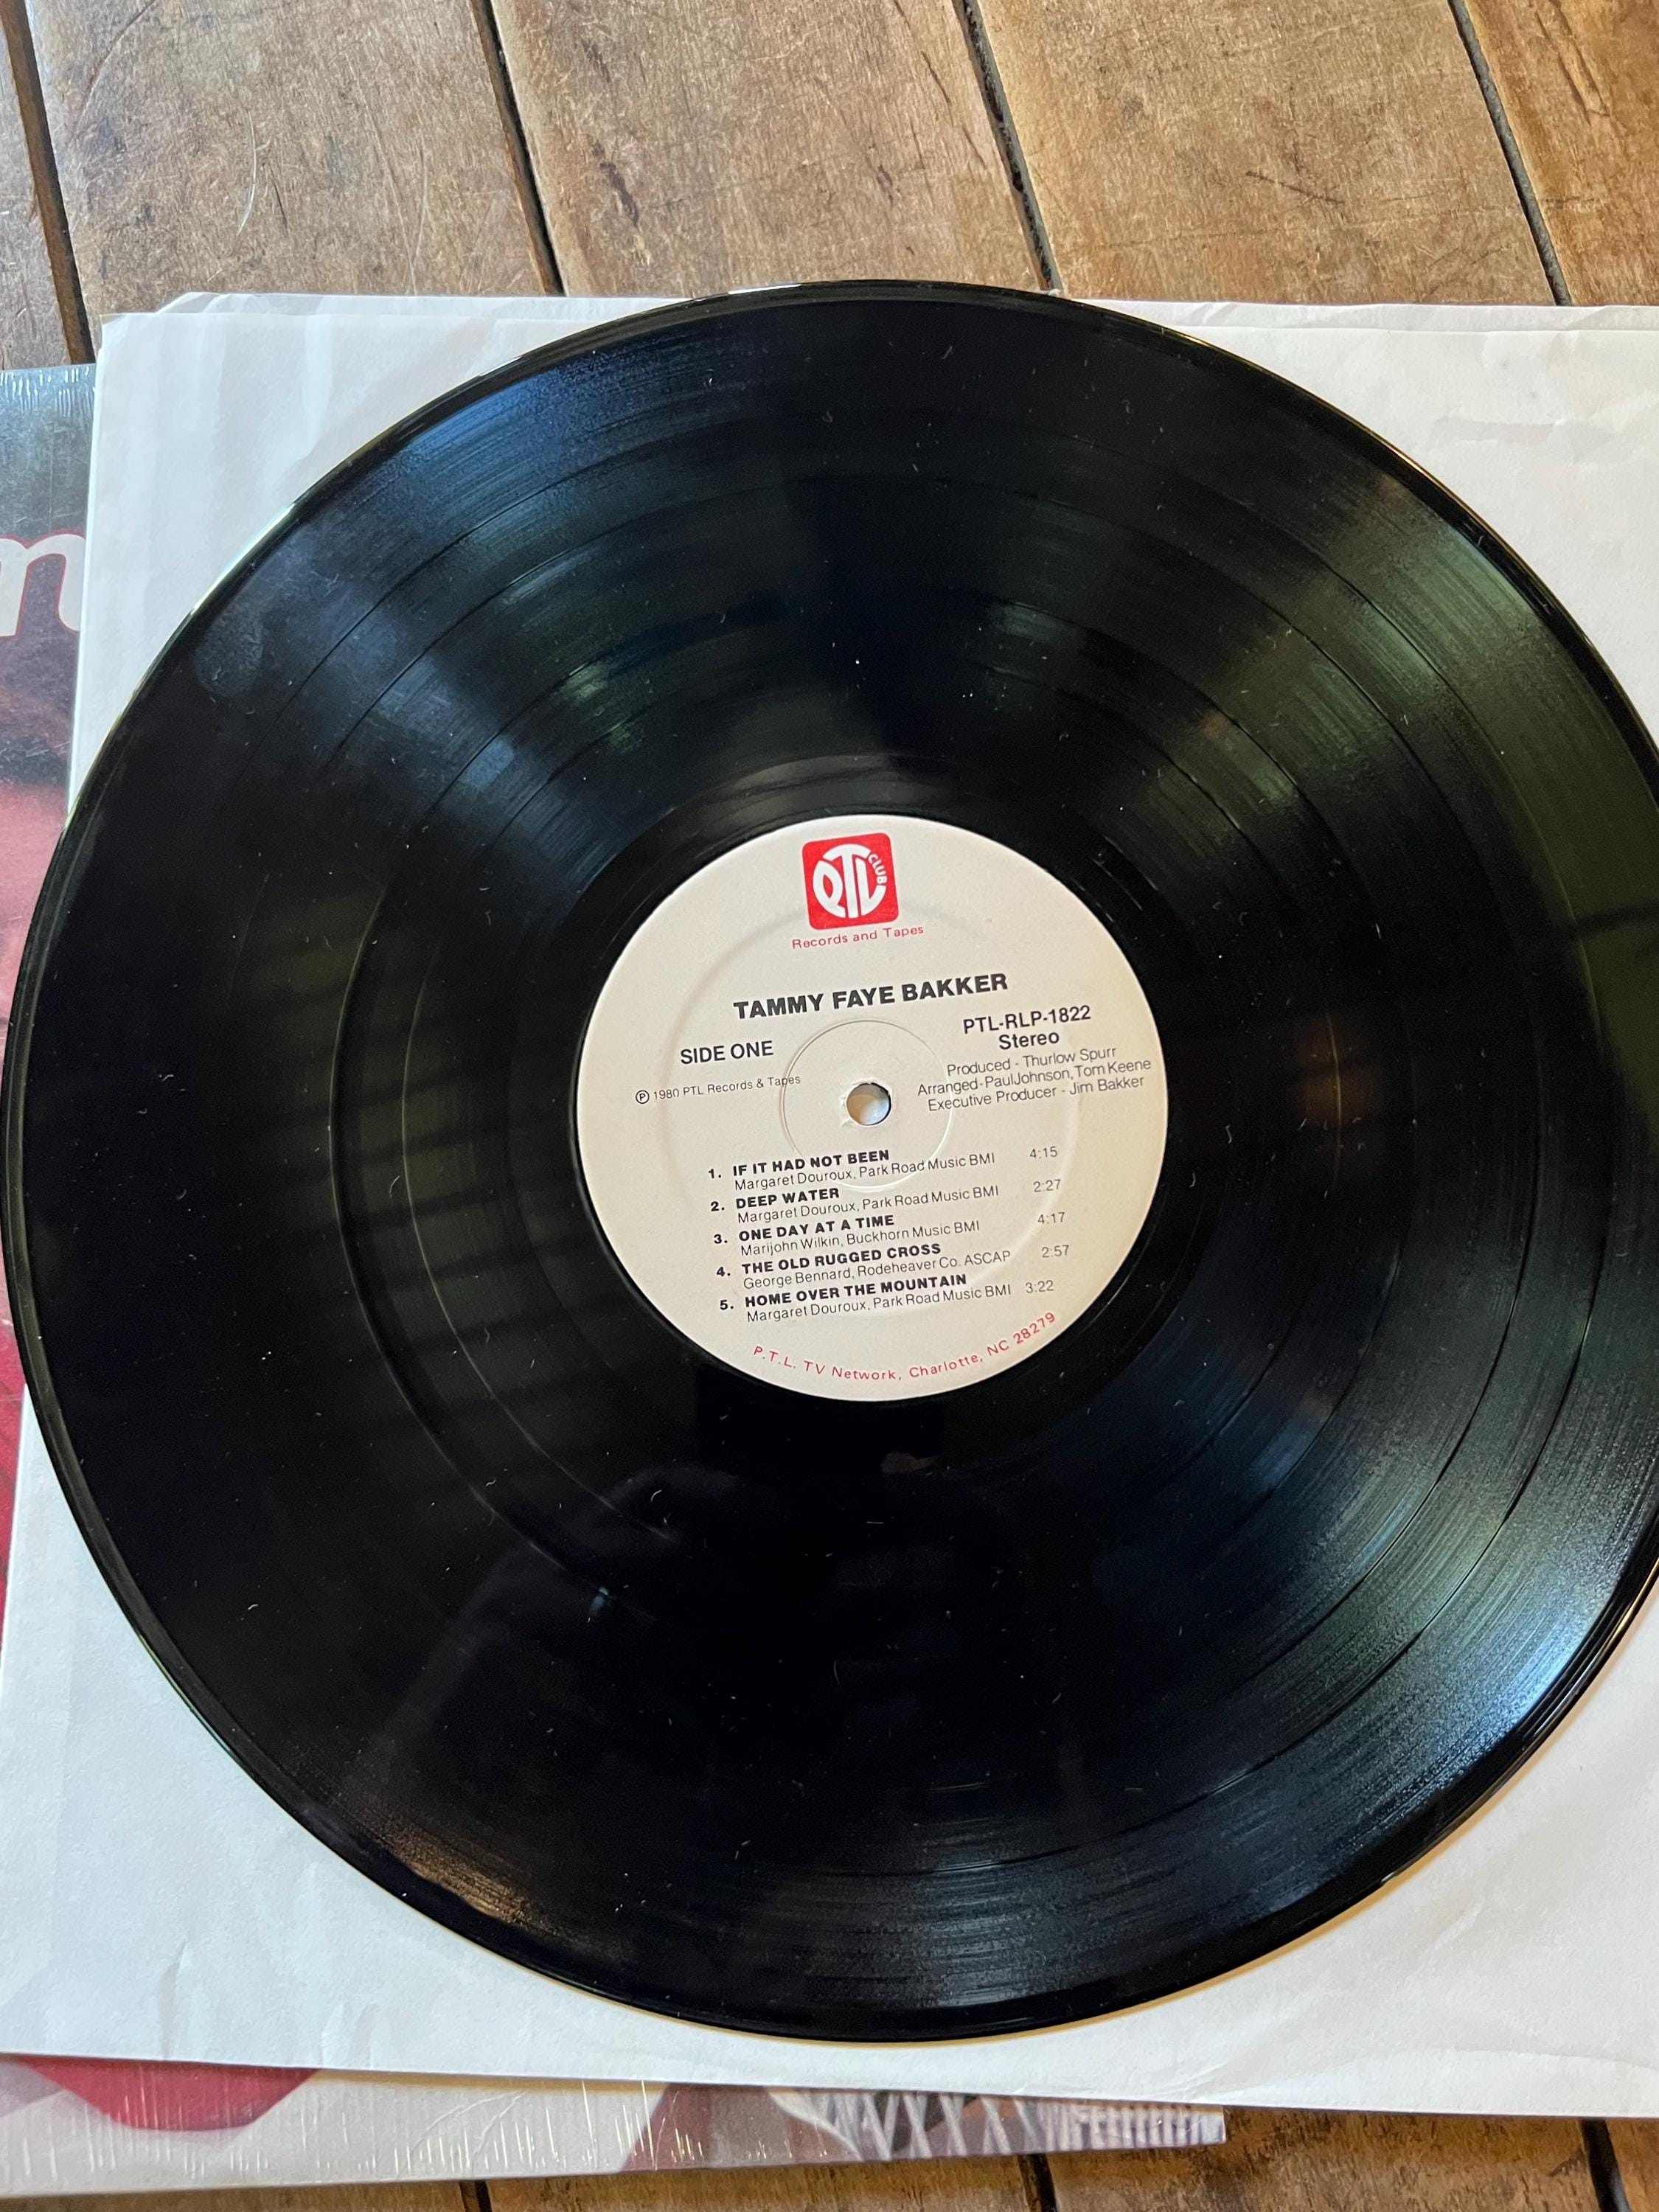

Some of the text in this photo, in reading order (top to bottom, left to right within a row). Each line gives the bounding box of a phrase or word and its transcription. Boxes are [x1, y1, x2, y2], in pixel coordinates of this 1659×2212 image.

[868, 854, 887, 885] CLUB
[793, 927, 923, 949] Records and Tapes
[733, 973, 1008, 1019] TAMMY FAYE BAKKER
[963, 1005, 1091, 1034] PTL-RLP-1822
[681, 1040, 773, 1064] SIDE ONE
[998, 1032, 1060, 1050] Stereo
[947, 1058, 1010, 1077] Produced
[1022, 1053, 1076, 1068] Thurlow
[1080, 1048, 1116, 1062] Spurr
[1074, 1065, 1105, 1077] Tom
[1107, 1060, 1151, 1074] Keene
[654, 1088, 679, 1099] 1980
[684, 1086, 704, 1096] PTL
[708, 1081, 753, 1093] Records
[757, 1079, 764, 1088] &
[768, 1077, 800, 1085] Tapes
[928, 1095, 991, 1111] Executive
[996, 1088, 1057, 1103] Producer
[1070, 1082, 1093, 1095] Jim
[1098, 1077, 1144, 1091] Bakker
[709, 1150, 889, 1178] 1. IF IT HAD NOT BEEN
[1030, 1146, 1057, 1158] 4:15
[735, 1152, 994, 1190] Margaret Douroux, Park Road Music BMI
[1034, 1179, 1060, 1192] 2:27
[711, 1188, 839, 1211] 2. DEEP WATER
[738, 1186, 998, 1223] Margaret Douroux, Park Road Music BMI
[714, 1215, 894, 1244] 3. ONE DAY AT A TIME
[1038, 1211, 1065, 1224] 4:17
[741, 1220, 979, 1256] Marijohn Wilkin, Buckhorn Music BMI
[1042, 1245, 1069, 1258] 2:57
[717, 1243, 941, 1277] 4. THE OLD RUGGED CROSS
[744, 1251, 1010, 1289] George Bennard, Rodeheaver Co. ASCAP
[720, 1274, 966, 1310] 5. HOME OVER THE MOUNTAIN
[1026, 1280, 1054, 1293] 3:22
[748, 1284, 1011, 1322] Margaret Douroux, Park Road Music BMI
[804, 1360, 825, 1375] TV
[832, 1366, 902, 1380] Network,
[909, 1354, 983, 1377] Charlotte,
[987, 1340, 1009, 1356] NC
[1013, 1312, 1055, 1344] 28279
